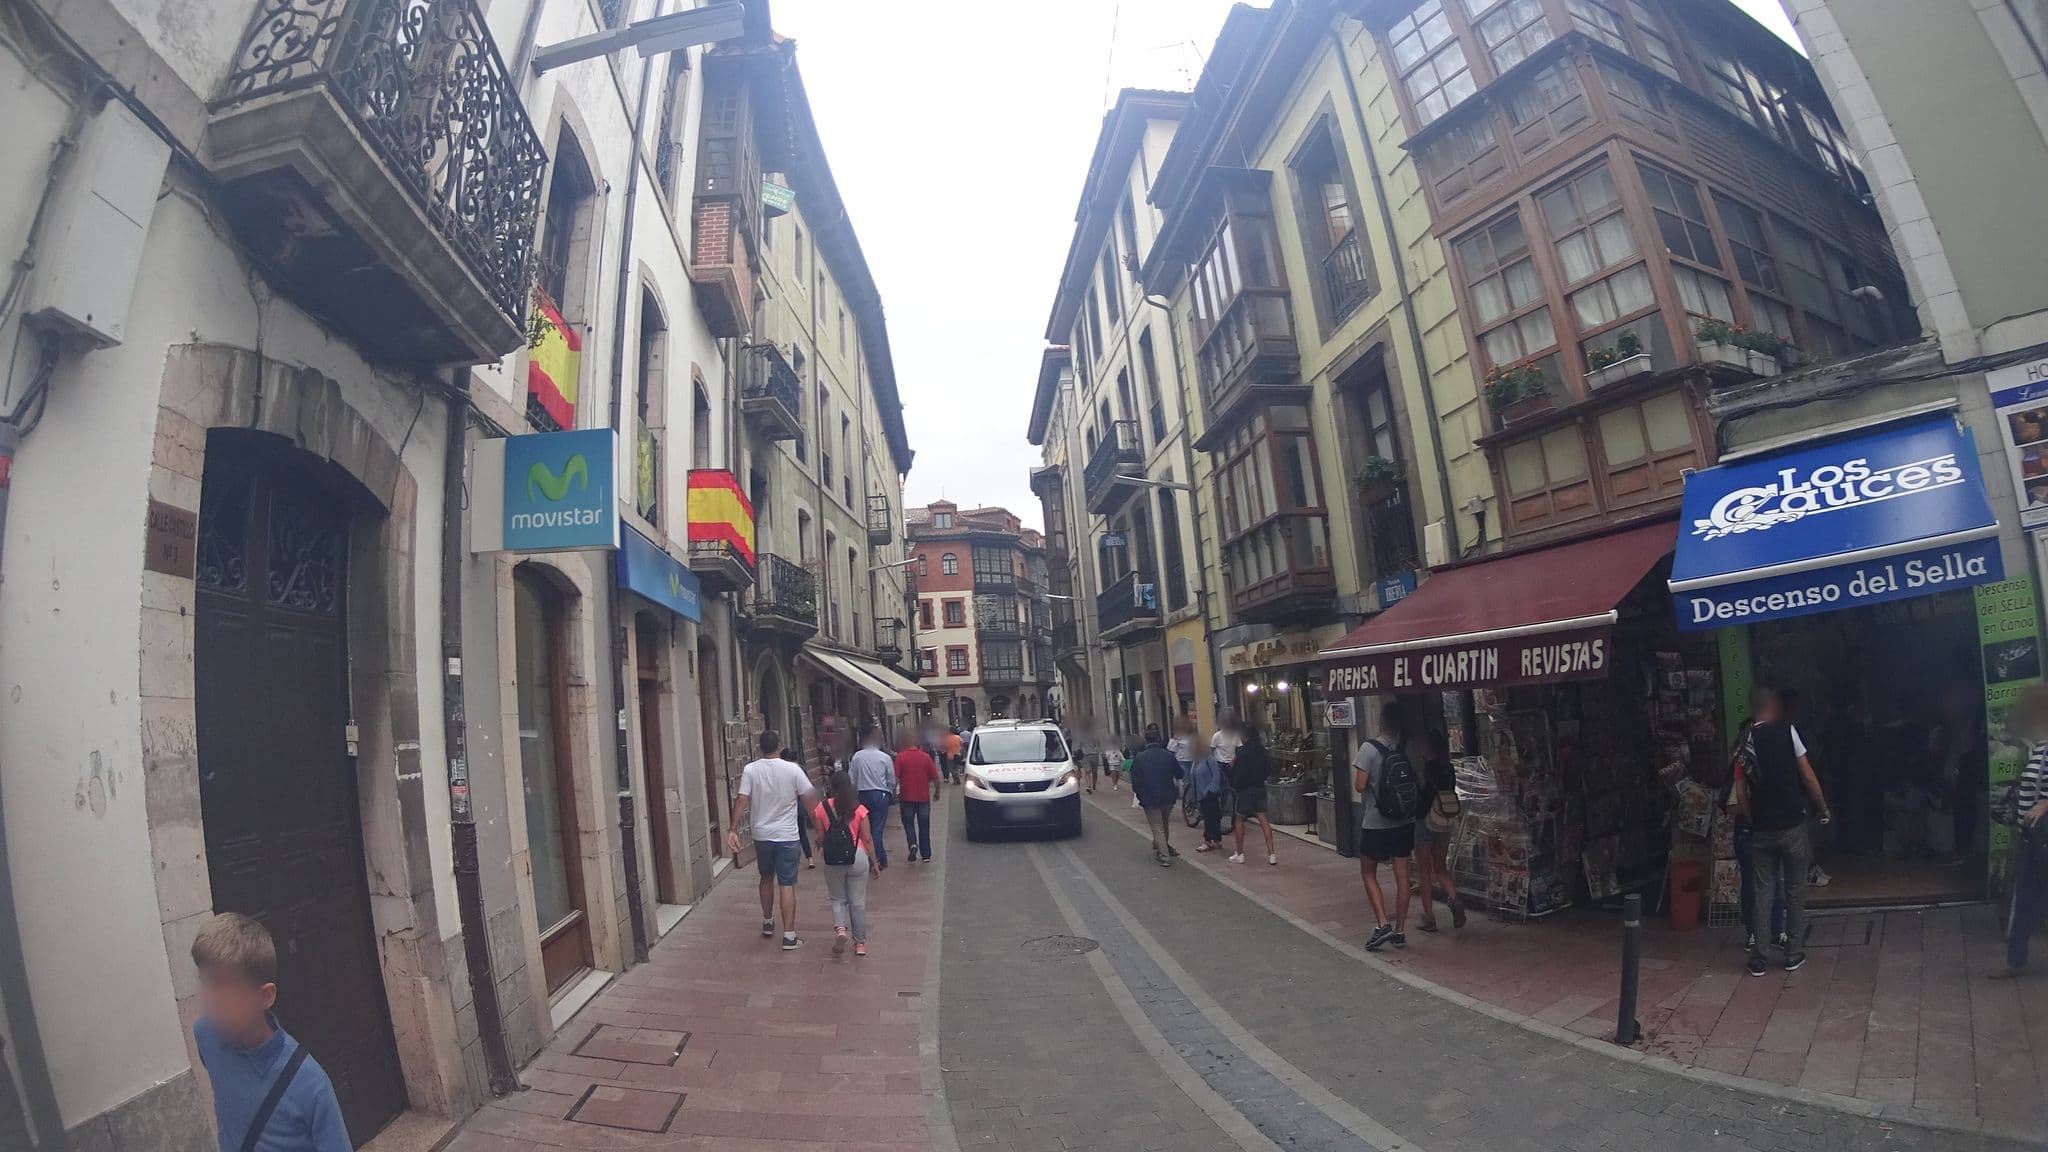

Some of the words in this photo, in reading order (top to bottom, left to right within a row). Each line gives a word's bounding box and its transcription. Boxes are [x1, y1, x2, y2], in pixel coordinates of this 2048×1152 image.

[511, 508, 603, 530] movistar
[1690, 583, 1841, 624] Descenso
[1848, 565, 1899, 598] del
[1904, 552, 1989, 588] Sella
[1977, 579, 2028, 597] Descenso
[1980, 603, 1998, 616] del
[2000, 596, 2034, 613] SELLA
[1983, 623, 1997, 635] en
[2000, 617, 2035, 632] Canoa
[1328, 664, 1379, 692] PRENSA
[1393, 657, 1413, 688] EL
[1421, 647, 1499, 685] CUARTIN
[1521, 639, 1604, 677] REVISTAS
